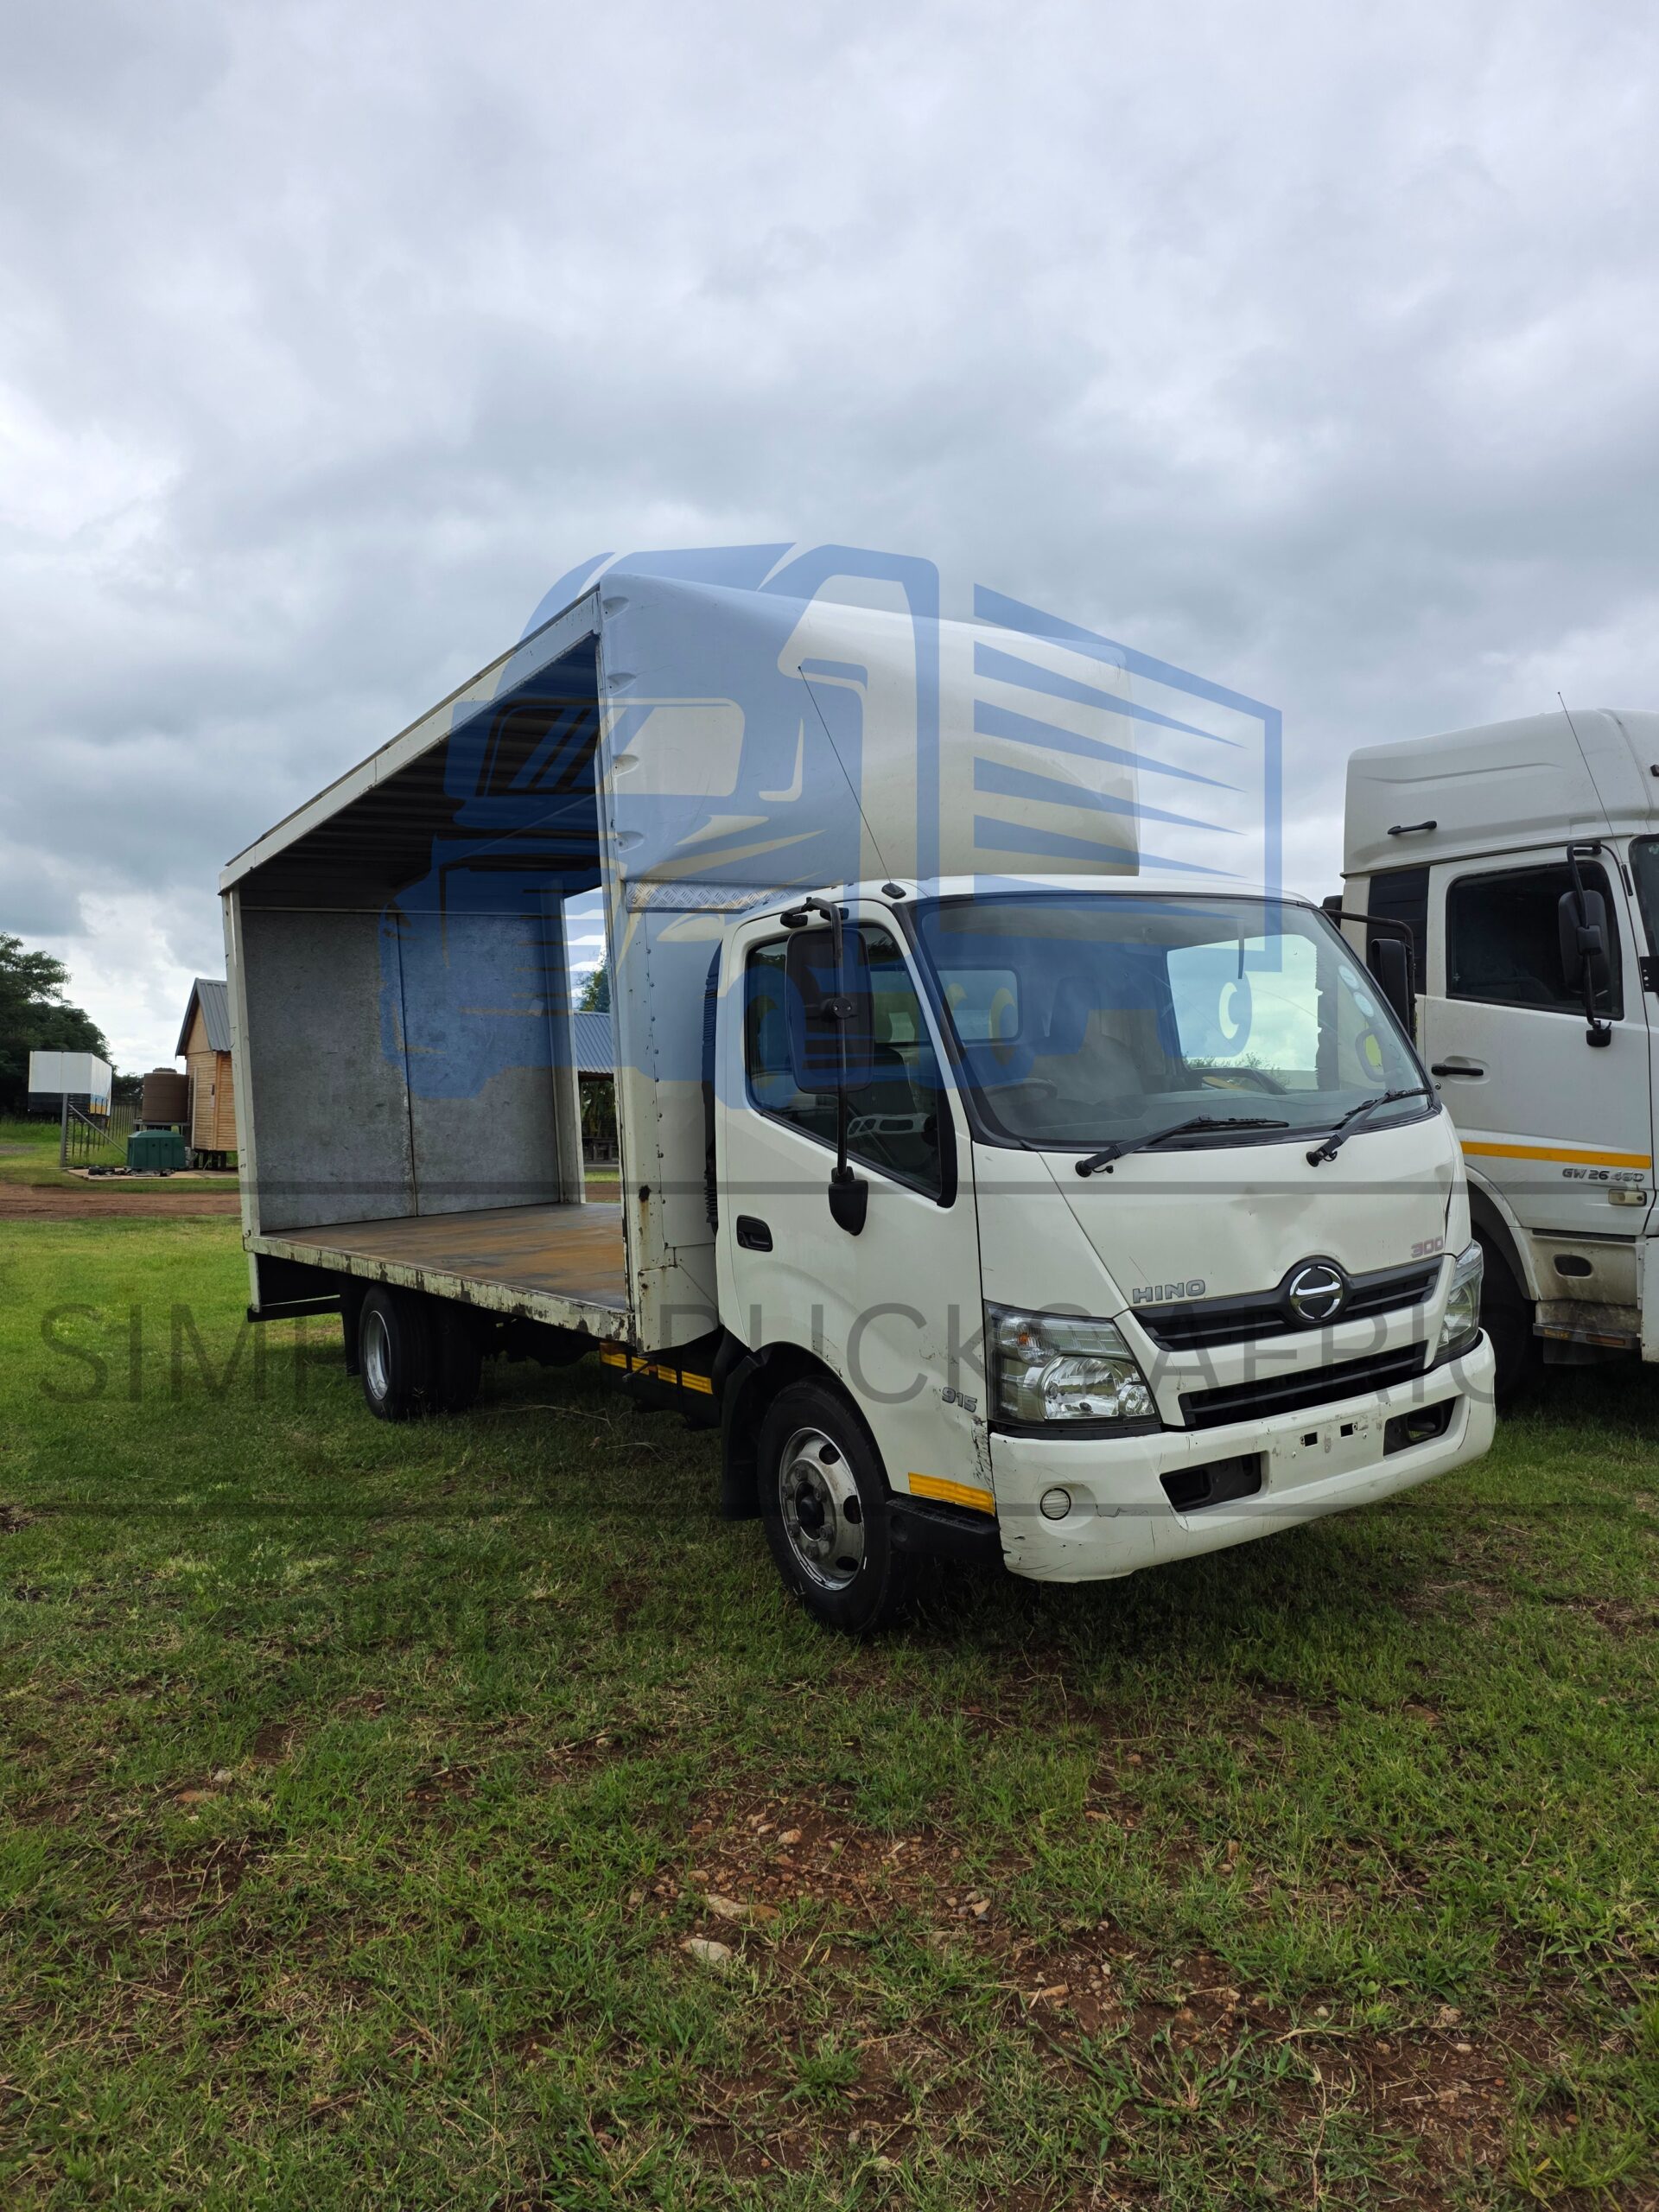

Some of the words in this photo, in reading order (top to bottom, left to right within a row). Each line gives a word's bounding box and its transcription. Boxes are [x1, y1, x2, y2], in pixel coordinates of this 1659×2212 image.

[1562, 1168, 1586, 1179] GW
[1588, 1169, 1610, 1180] 26
[1410, 1235, 1444, 1259] 300
[1132, 1279, 1205, 1304] HINO
[942, 1386, 978, 1413] 915
